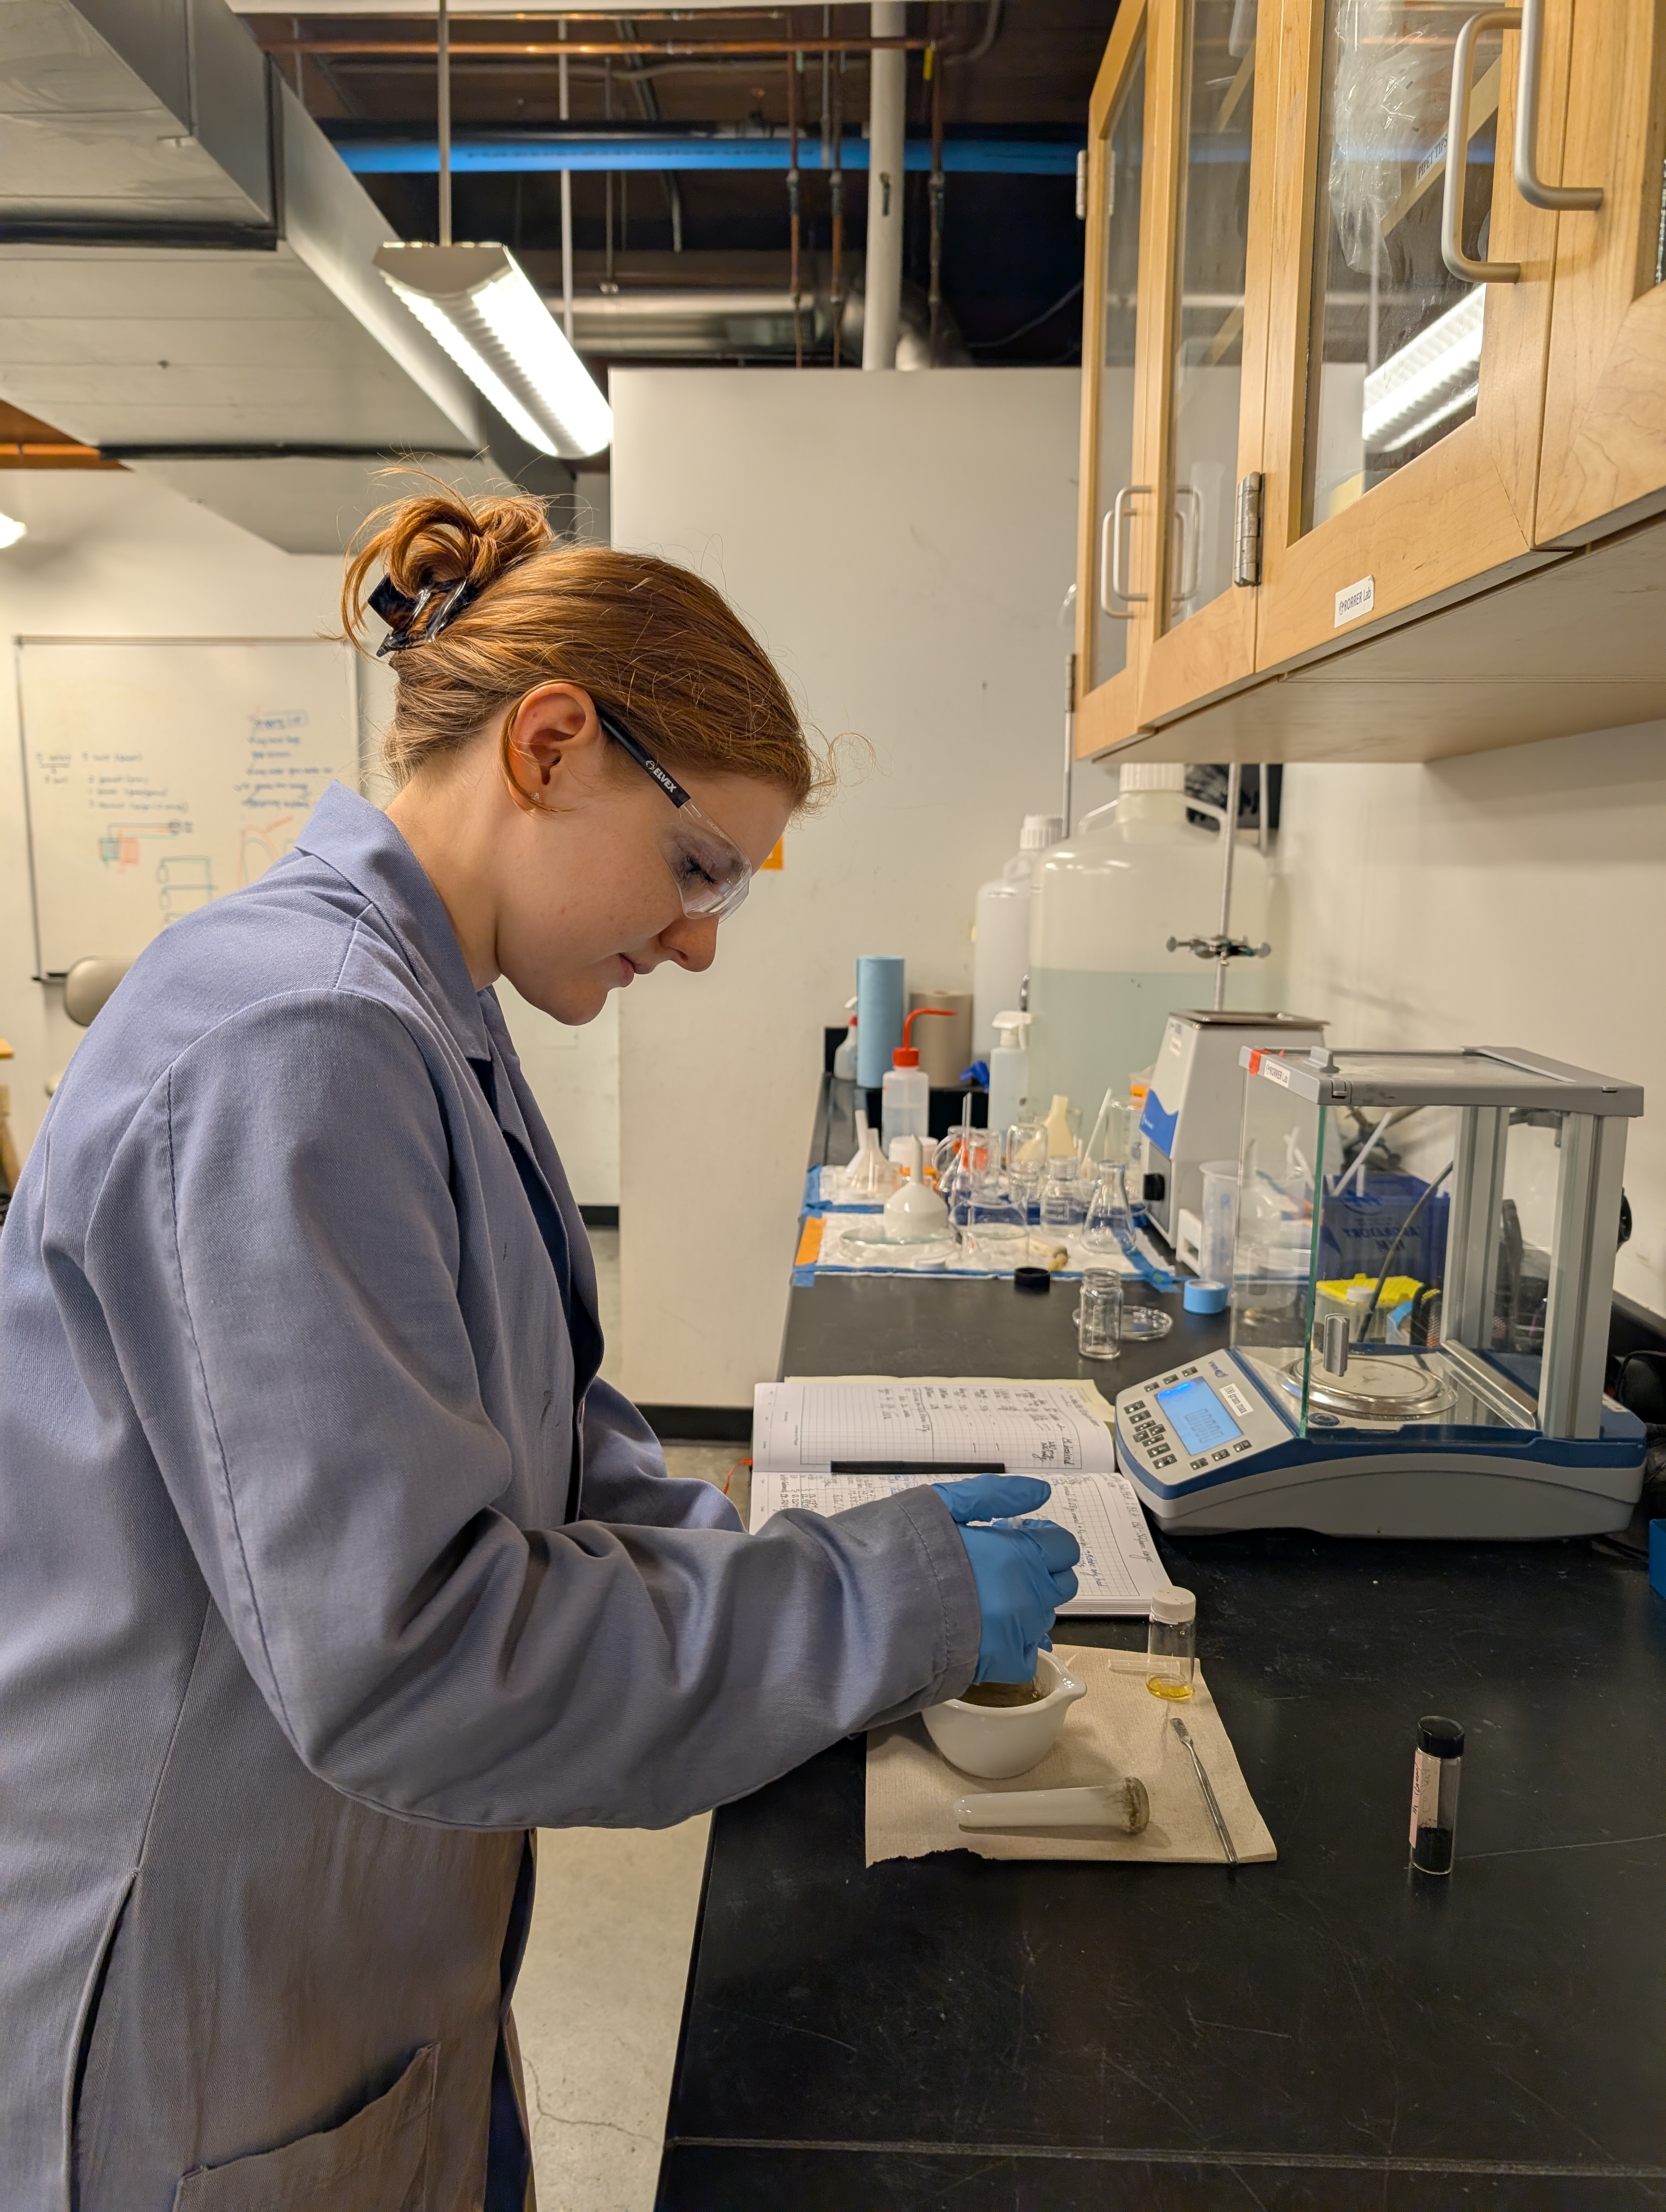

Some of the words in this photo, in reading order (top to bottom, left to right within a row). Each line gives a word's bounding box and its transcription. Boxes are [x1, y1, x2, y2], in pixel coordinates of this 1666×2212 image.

[1418, 150, 1434, 180] PIPET
[1435, 133, 1448, 158] TIPS
[1344, 591, 1362, 612] RORRER
[652, 767, 677, 793] ELVEX
[1269, 1066, 1283, 1080] RORRER
[1208, 1360, 1219, 1371] VWR
[1223, 1386, 1234, 1394] 100
[1228, 1393, 1240, 1405] gram
[1237, 1403, 1247, 1414] max
